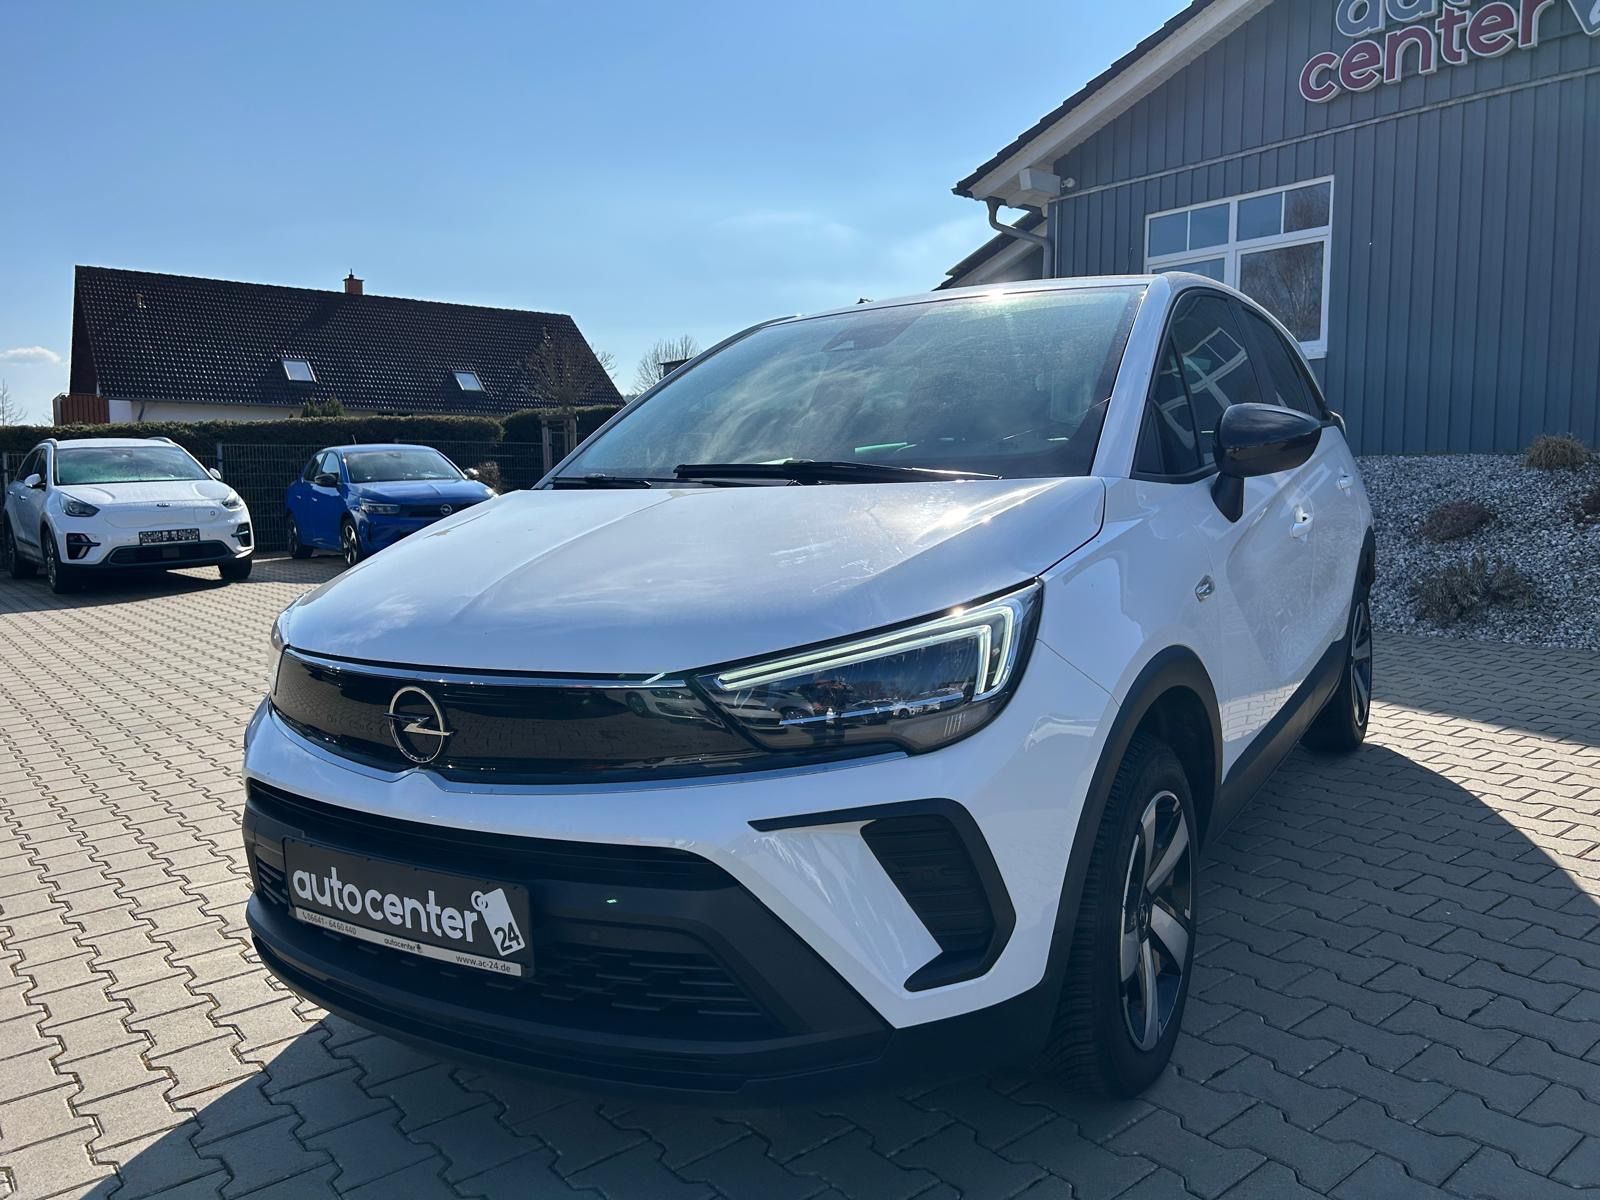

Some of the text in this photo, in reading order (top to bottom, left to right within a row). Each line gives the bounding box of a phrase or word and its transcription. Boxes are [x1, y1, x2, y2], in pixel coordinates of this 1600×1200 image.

[1299, 0, 1552, 102] center
[292, 866, 477, 943] autocenter
[494, 922, 520, 952] 24
[455, 955, 511, 973] www.ac-24.de
